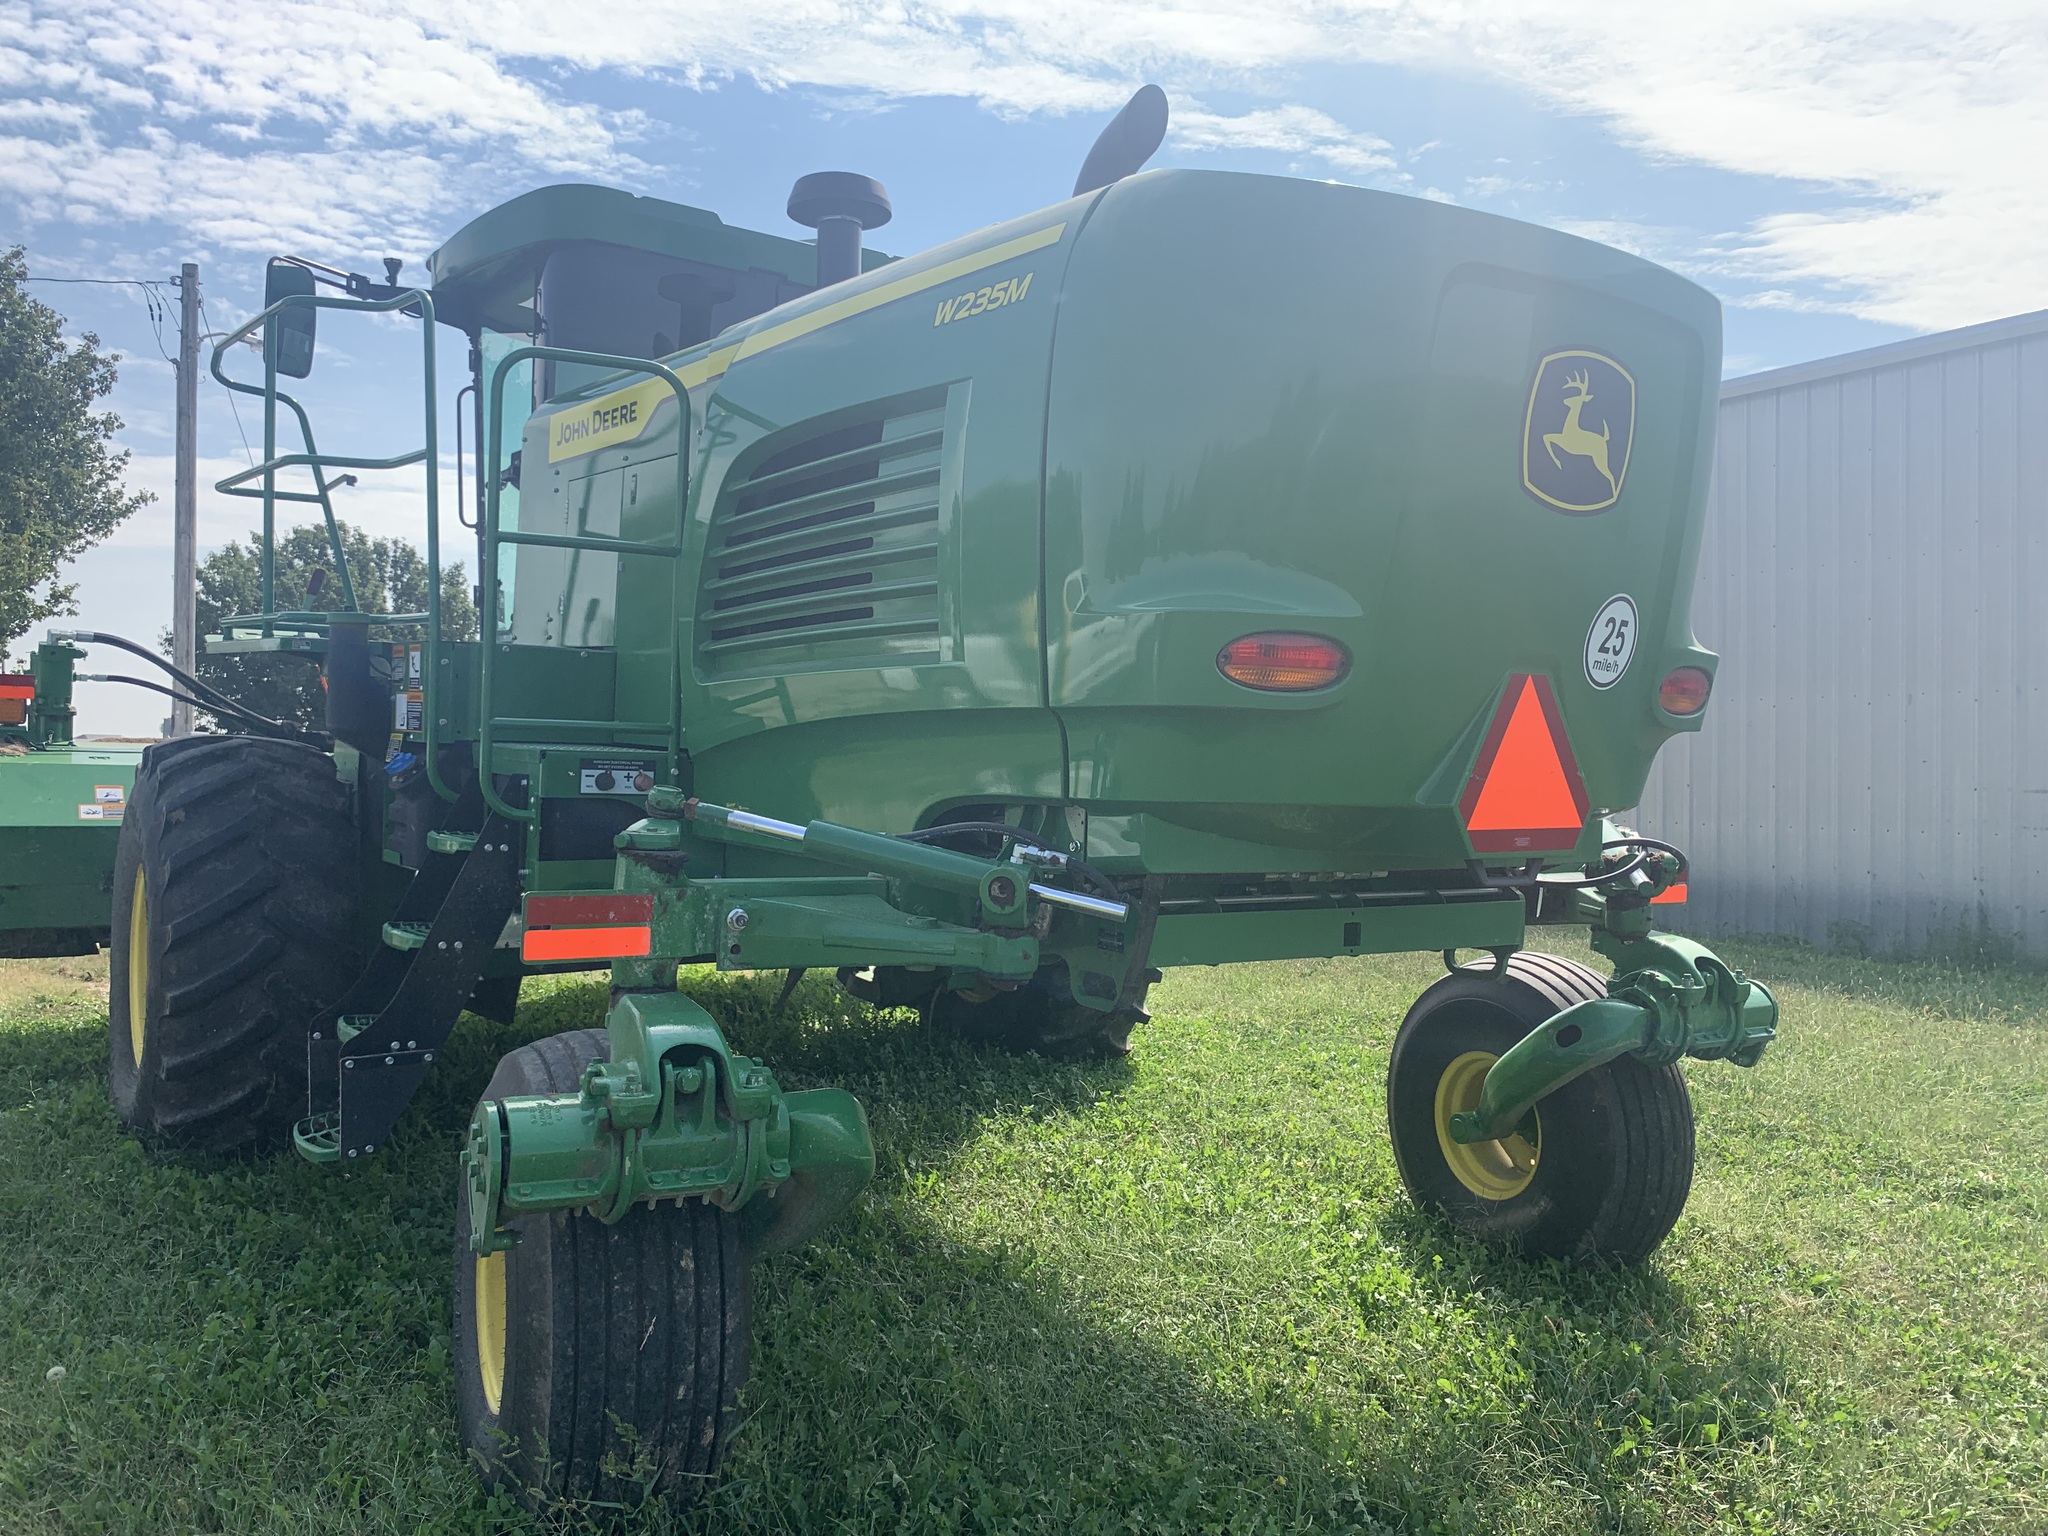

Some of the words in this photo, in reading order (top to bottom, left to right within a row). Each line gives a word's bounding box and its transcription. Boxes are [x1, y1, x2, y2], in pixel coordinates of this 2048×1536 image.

[933, 272, 1034, 328] W235M
[556, 417, 589, 446] JOHN
[593, 401, 638, 435] DEERE
[1598, 616, 1629, 656] 25
[1592, 658, 1619, 674] mile/h
